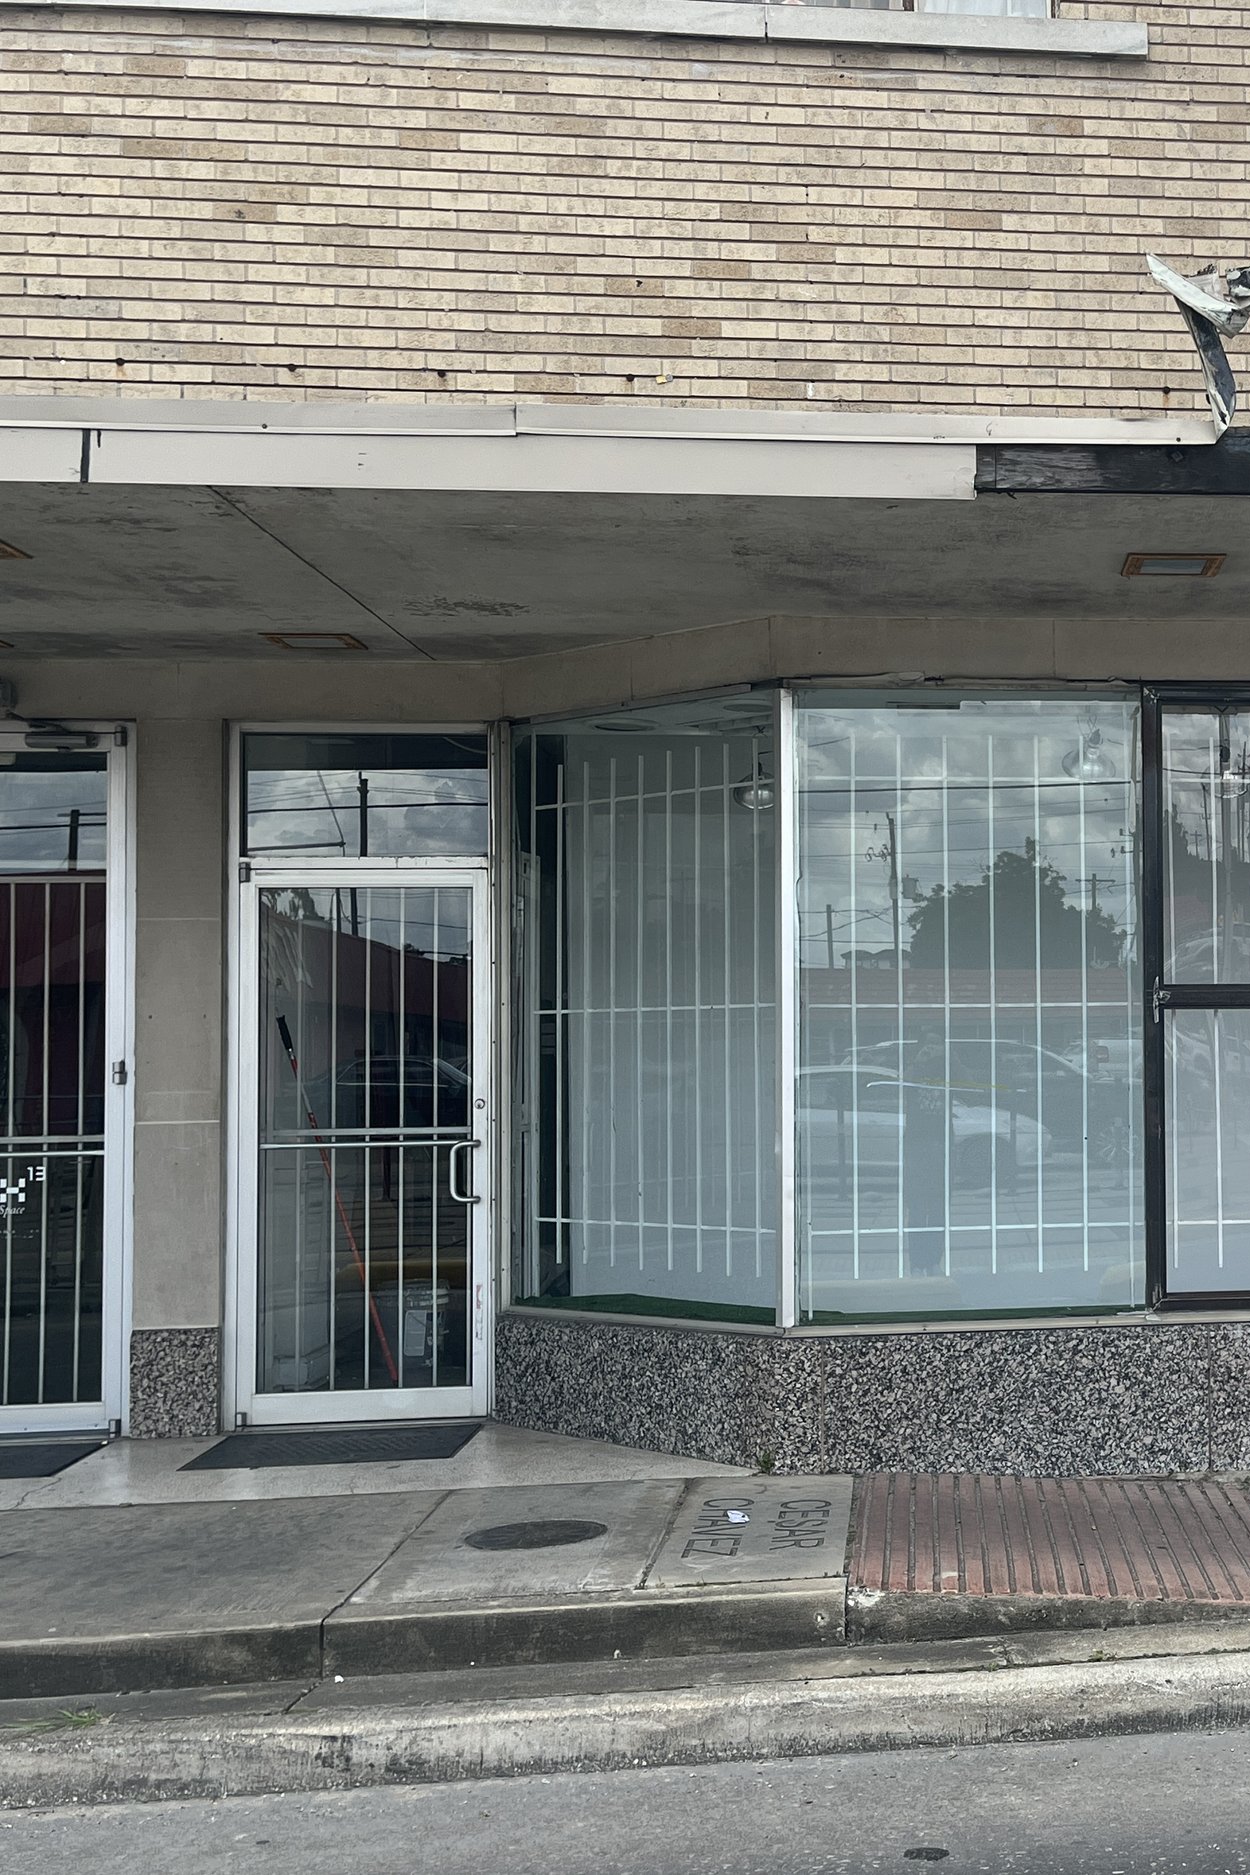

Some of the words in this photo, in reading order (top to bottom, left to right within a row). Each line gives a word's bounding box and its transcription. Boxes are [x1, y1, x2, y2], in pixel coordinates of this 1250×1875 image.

[27, 1166, 46, 1181] 13
[681, 1497, 755, 1558] CHAVEZ
[769, 1499, 832, 1550] CESAR
